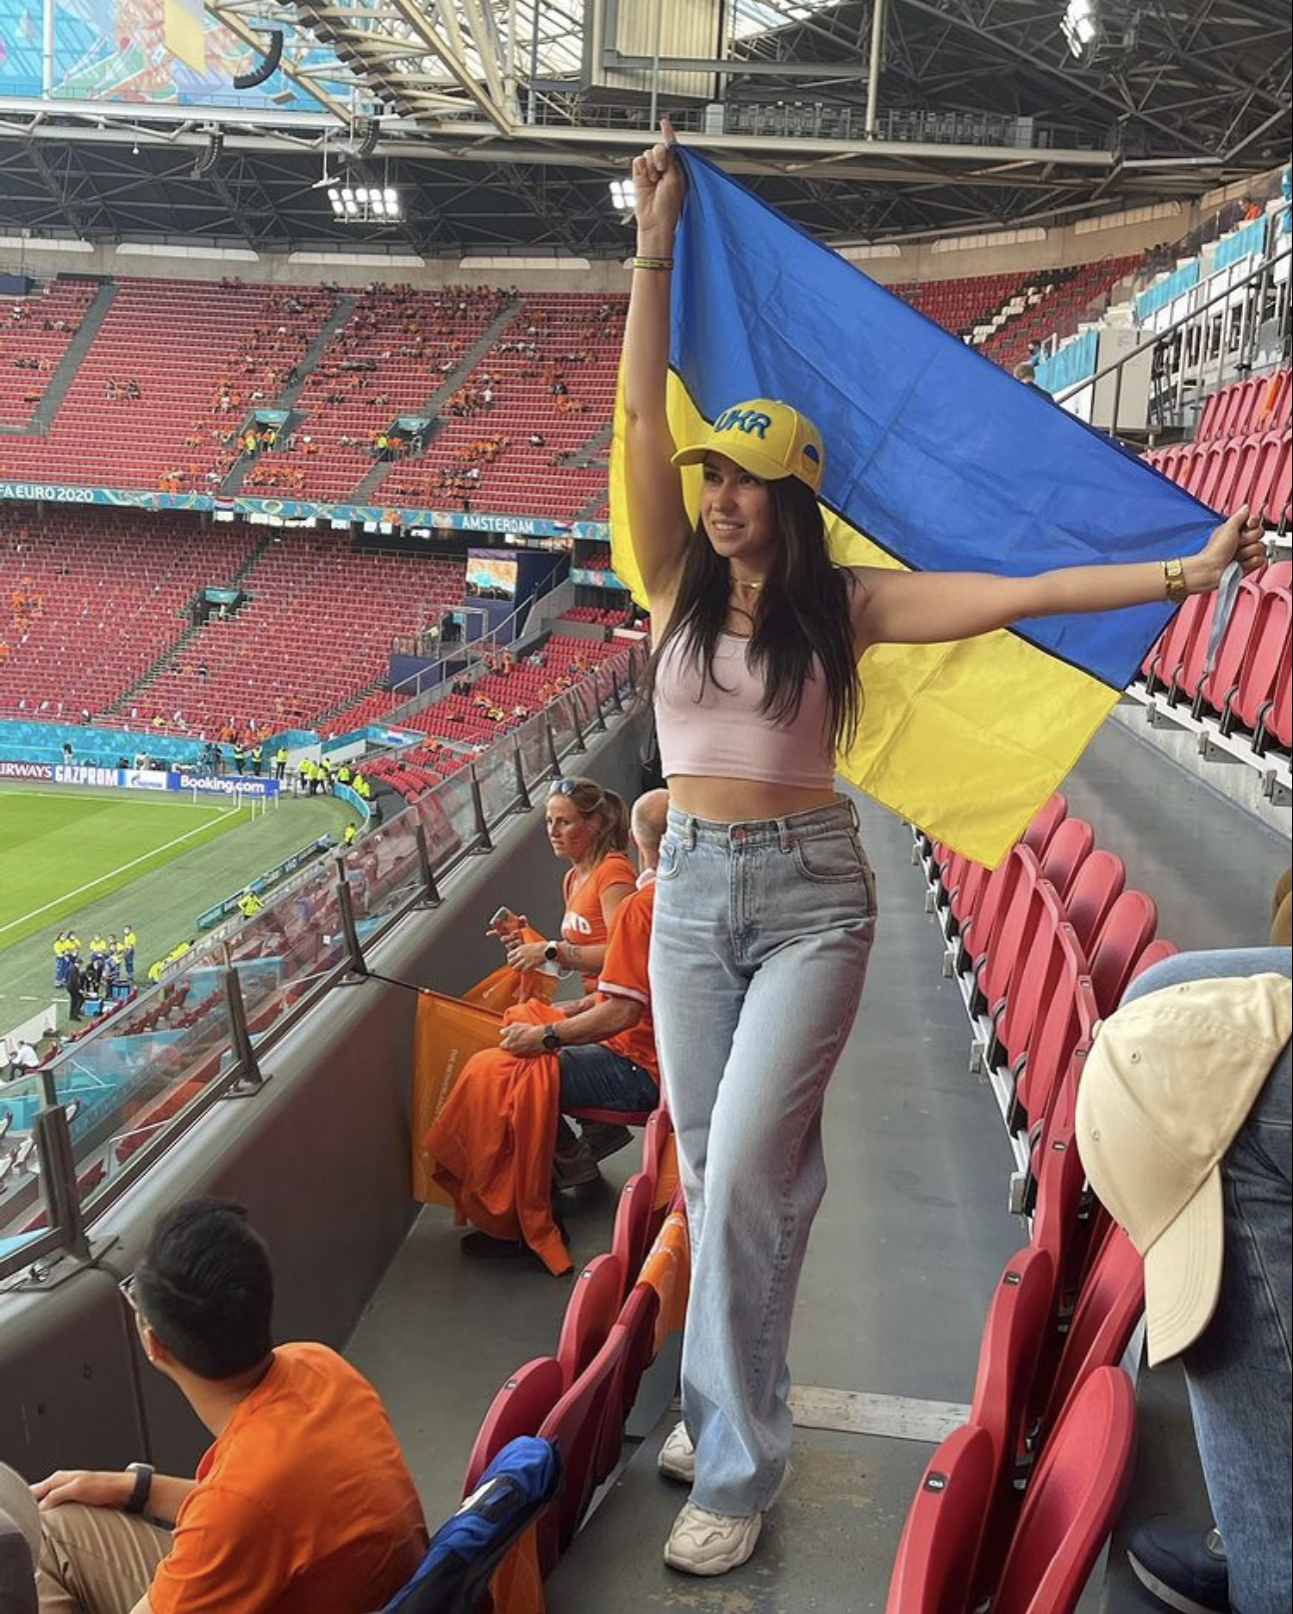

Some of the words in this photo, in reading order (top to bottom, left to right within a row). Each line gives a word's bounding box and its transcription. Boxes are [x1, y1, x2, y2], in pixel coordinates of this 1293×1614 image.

[714, 410, 771, 439] UKR
[16, 484, 55, 500] EURO
[57, 488, 94, 502] 2020
[462, 515, 535, 534] AMSTERDAM
[0, 763, 52, 778] IRWAYS
[55, 765, 118, 787] GAZPROM
[181, 775, 264, 793] Booking.com
